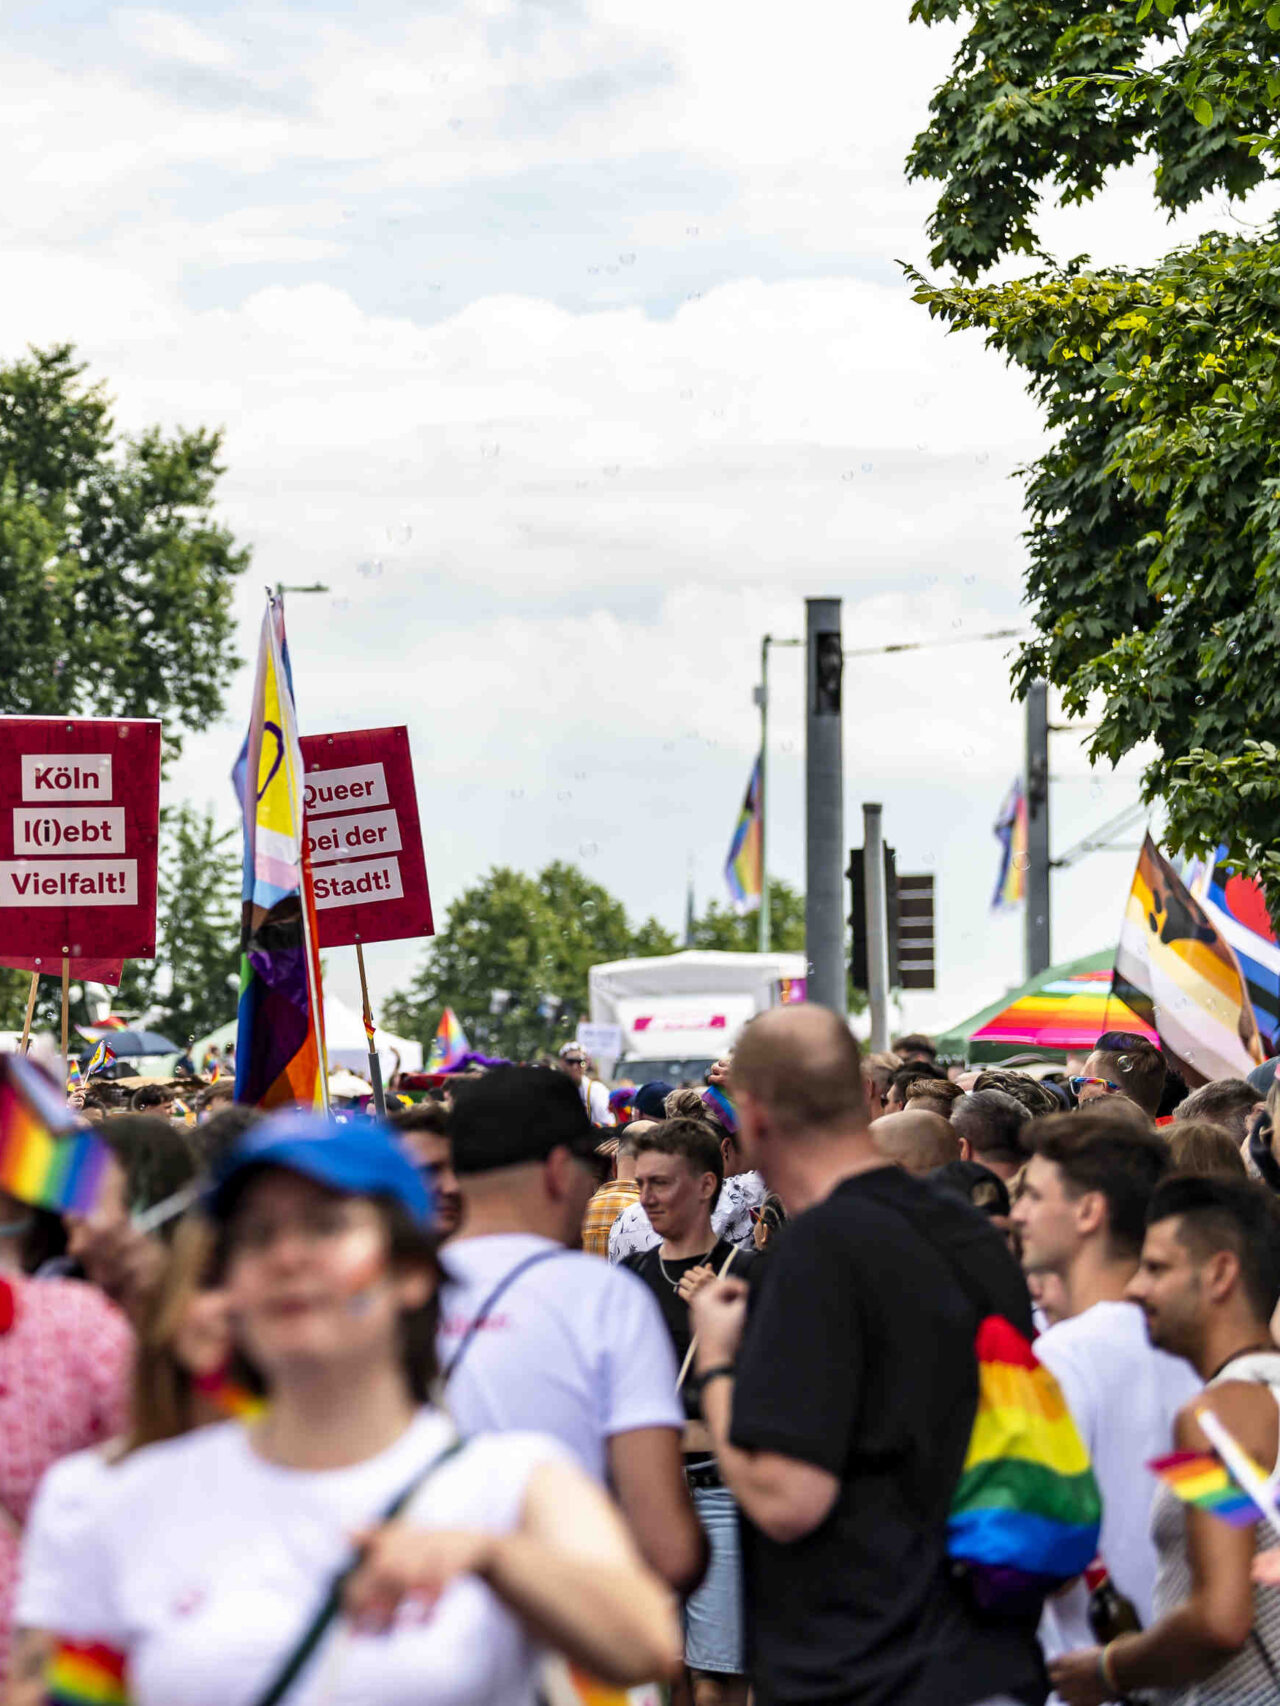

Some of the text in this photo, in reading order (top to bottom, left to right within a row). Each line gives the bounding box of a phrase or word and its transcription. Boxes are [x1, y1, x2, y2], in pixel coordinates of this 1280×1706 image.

[34, 767, 99, 789] Köln
[24, 819, 112, 846] l(i)ebt
[345, 825, 388, 847] der
[10, 872, 126, 895] Vielfalt!
[314, 869, 391, 899] Stadt!
